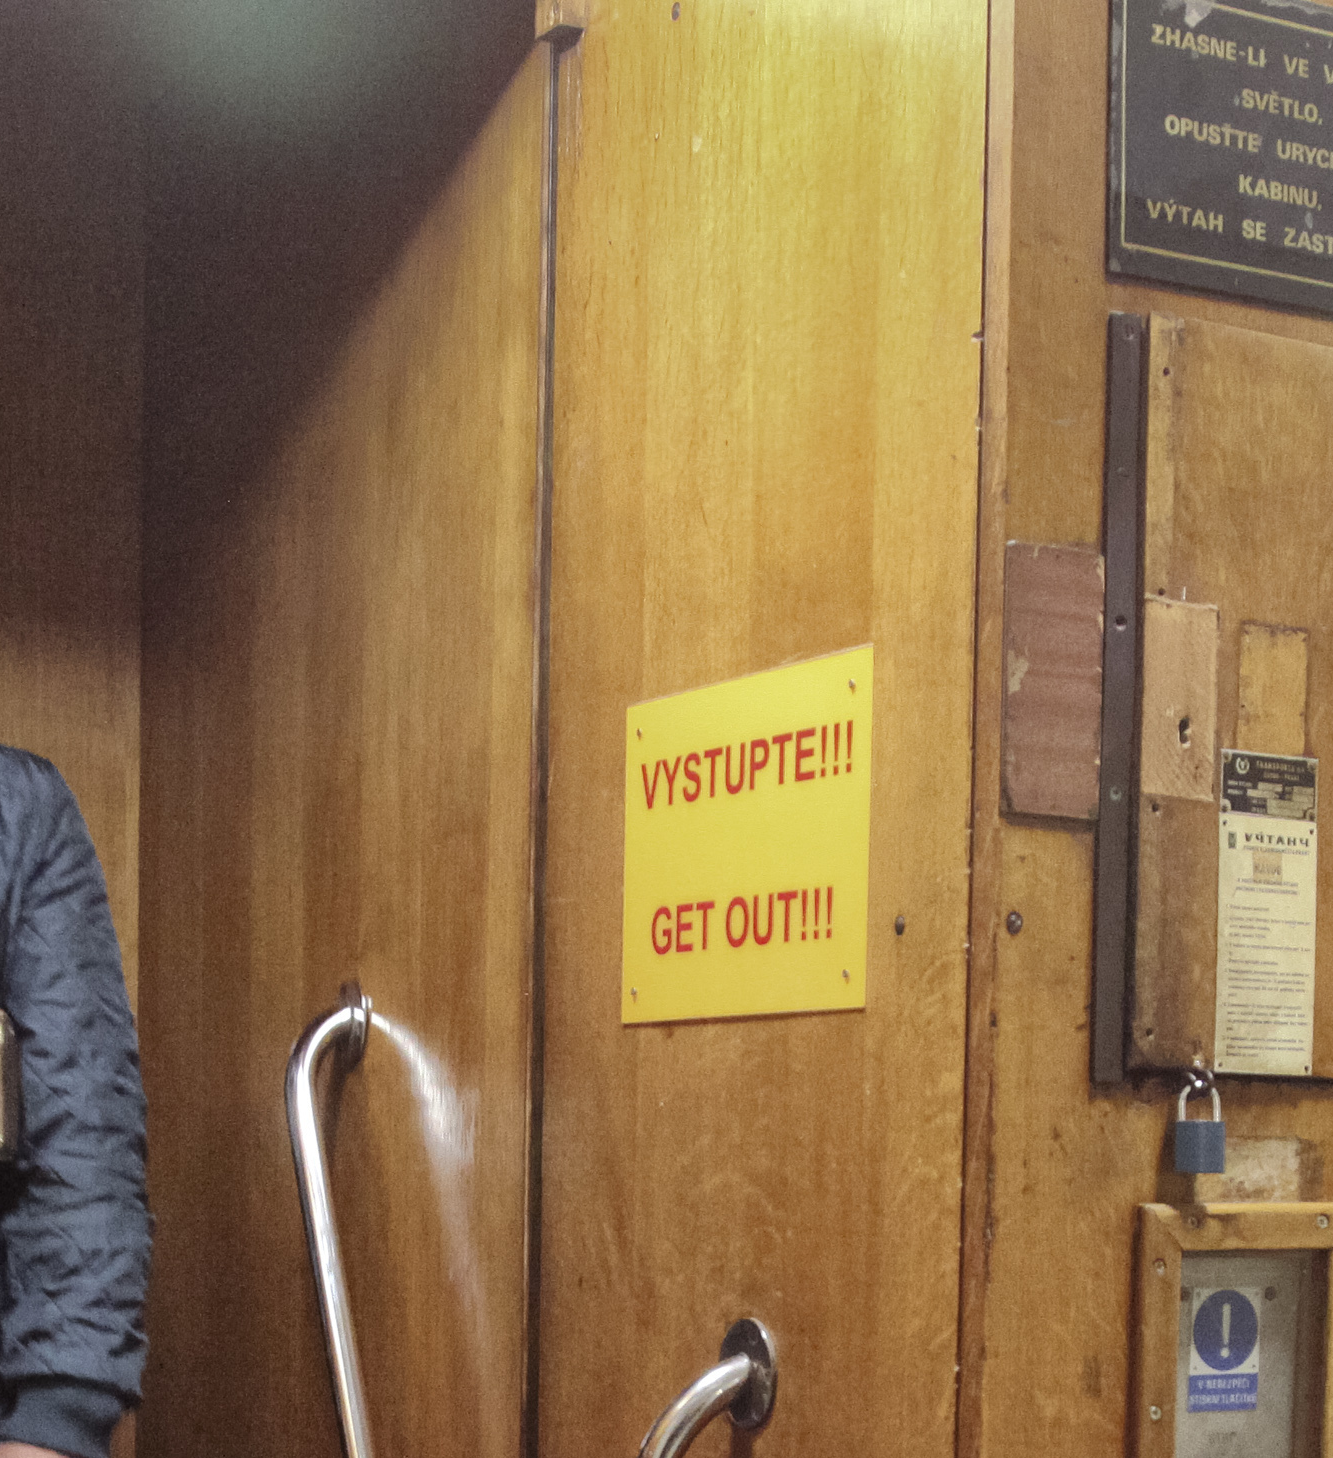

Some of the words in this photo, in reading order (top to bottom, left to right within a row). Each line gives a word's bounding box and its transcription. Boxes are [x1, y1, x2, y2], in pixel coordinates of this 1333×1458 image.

[1151, 23, 1267, 69] ZHASNE-LI
[1284, 54, 1310, 79] VE
[1241, 88, 1323, 125] SVĚTLO,
[1238, 174, 1322, 211] KABINU,
[1147, 199, 1224, 234] VÝTAH
[1242, 218, 1267, 243] SE
[641, 720, 854, 810] VYSTUPTE!!!
[651, 901, 715, 955] GET
[725, 886, 834, 949] OUT!!!
